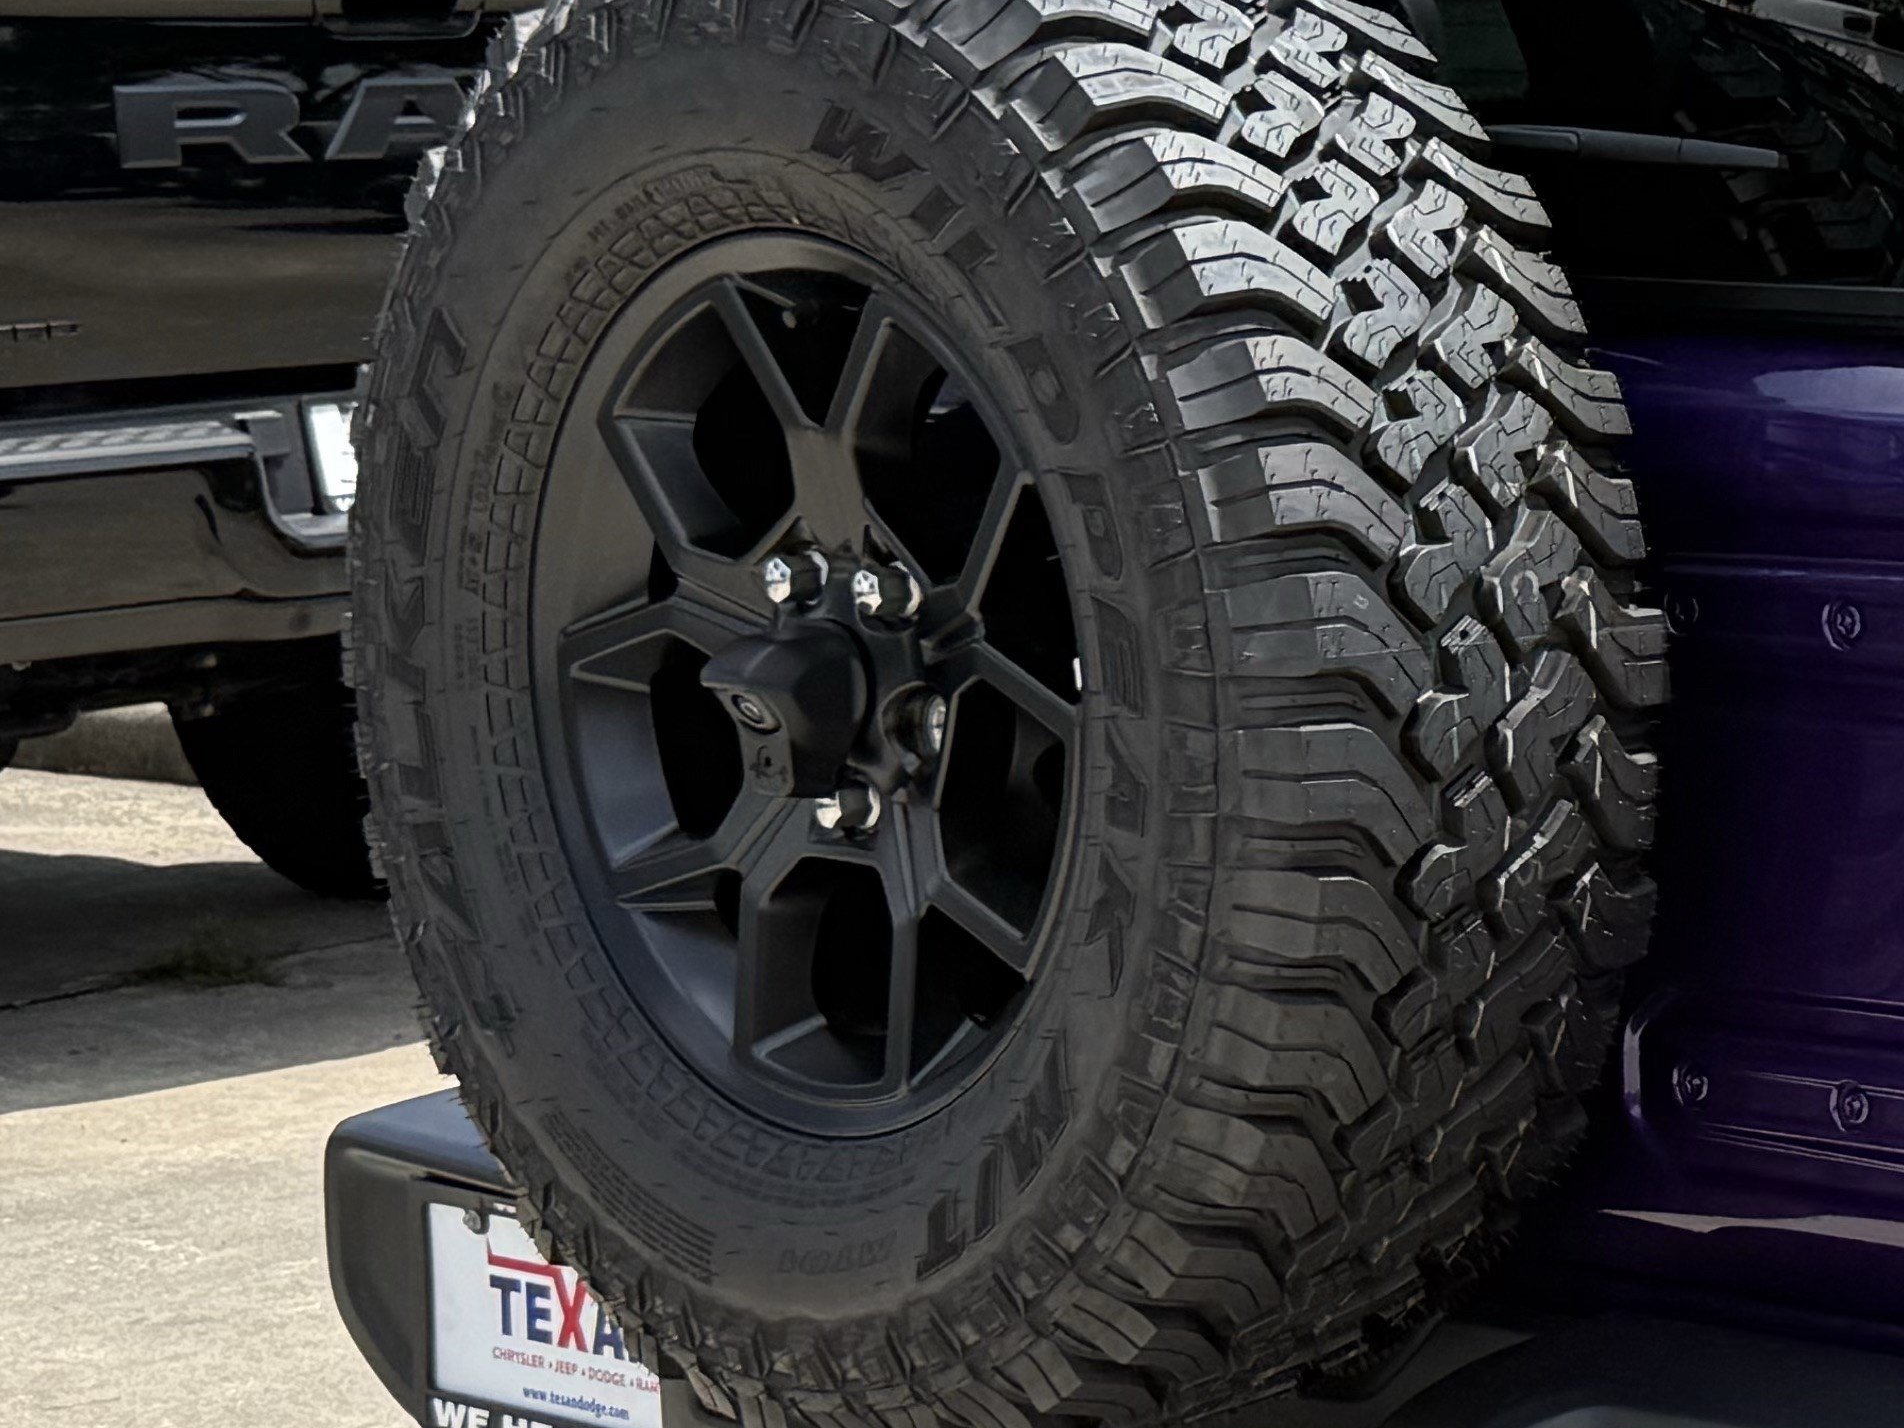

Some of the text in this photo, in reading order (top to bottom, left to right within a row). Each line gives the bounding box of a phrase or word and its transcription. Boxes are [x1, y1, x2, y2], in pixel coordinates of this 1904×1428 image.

[113, 74, 474, 170] RA
[489, 1273, 627, 1361] TEXA
[492, 1346, 545, 1369] CHRYSLER
[554, 1359, 578, 1375] JEEP
[588, 1366, 626, 1388] DODGE
